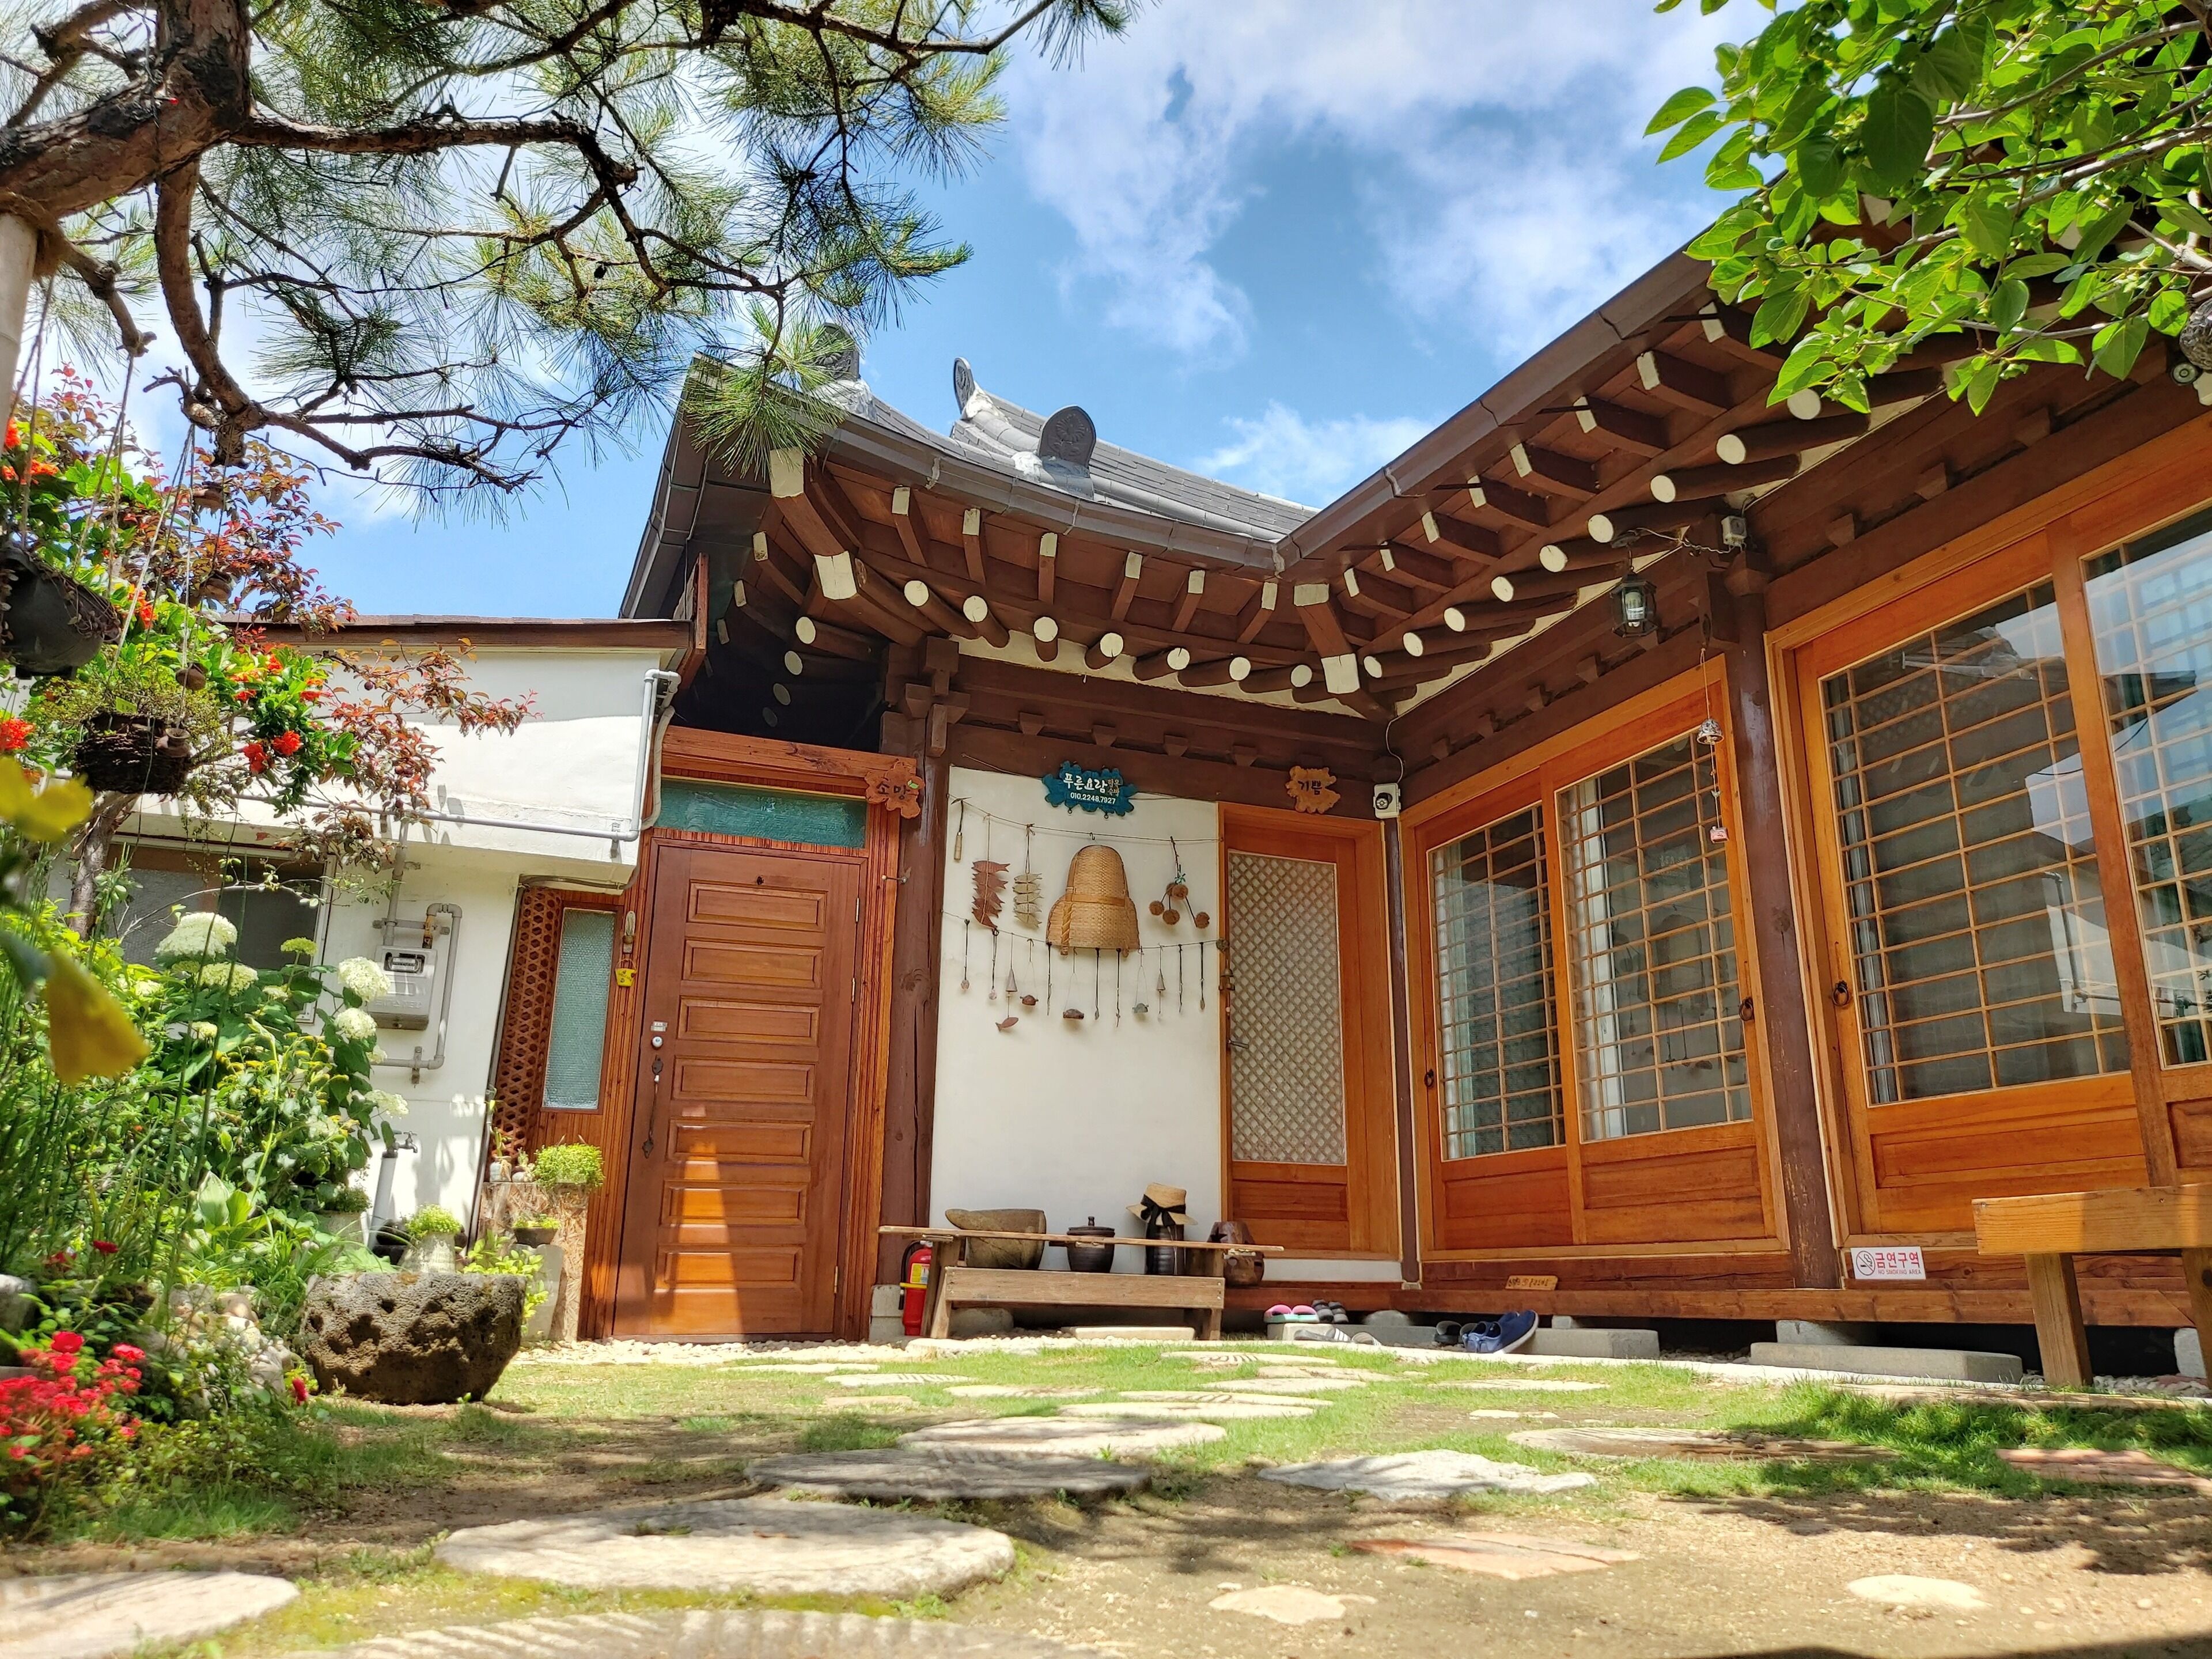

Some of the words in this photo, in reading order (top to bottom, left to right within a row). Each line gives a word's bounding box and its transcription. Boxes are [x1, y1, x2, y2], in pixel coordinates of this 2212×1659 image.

[1063, 772, 1108, 793] 푸른요람
[1298, 781, 1322, 795] 기쁨
[877, 782, 911, 800] 소망
[1070, 792, 1116, 804] 010.2248.7927
[1875, 1252, 1920, 1268] 금연구역
